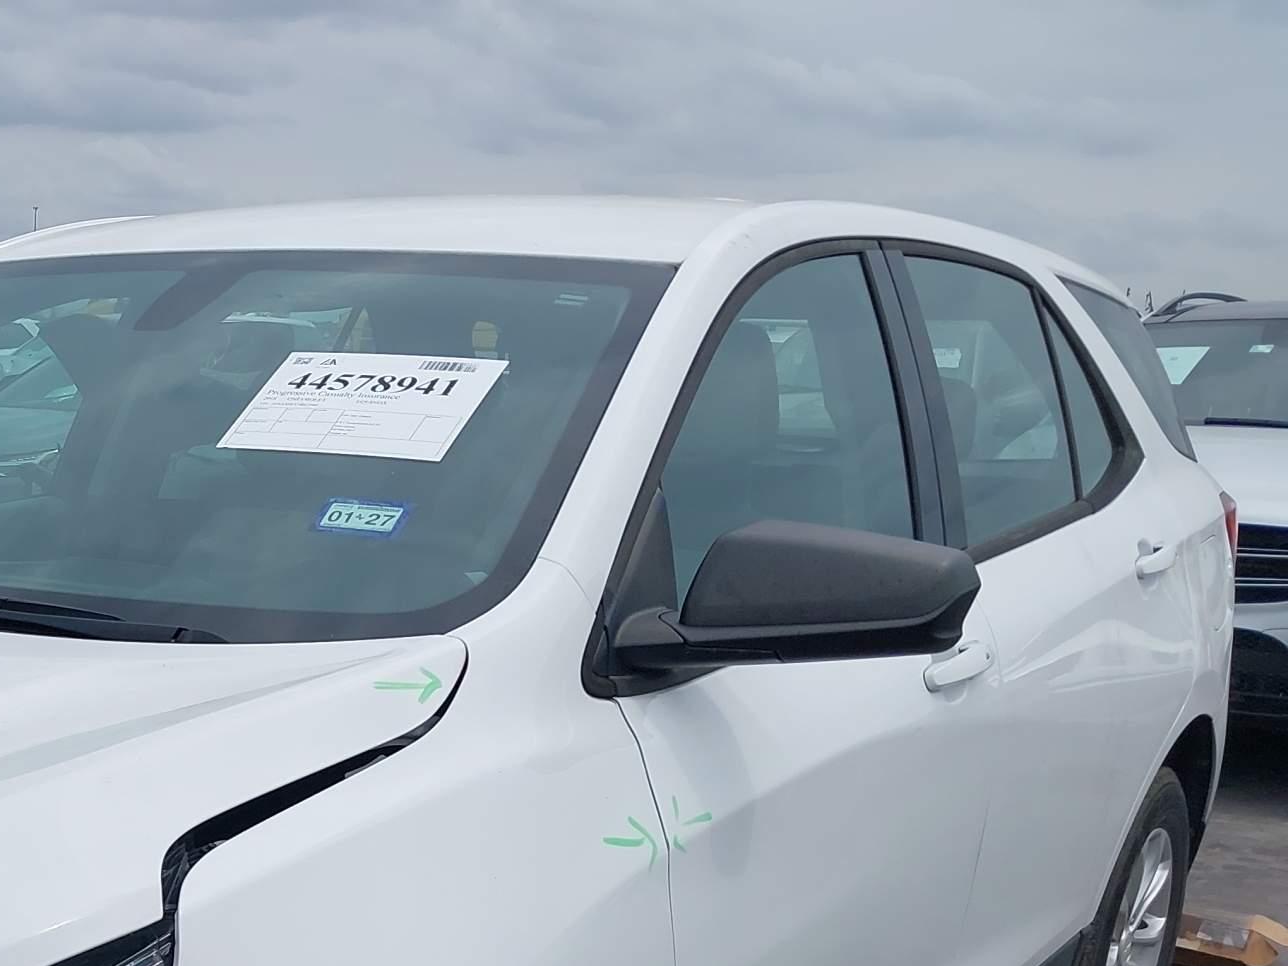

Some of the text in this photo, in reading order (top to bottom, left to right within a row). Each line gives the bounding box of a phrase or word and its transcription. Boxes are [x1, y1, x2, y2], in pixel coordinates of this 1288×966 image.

[288, 372, 459, 397] 44578941
[358, 392, 401, 400] Insurance
[327, 510, 396, 527] 01 27
